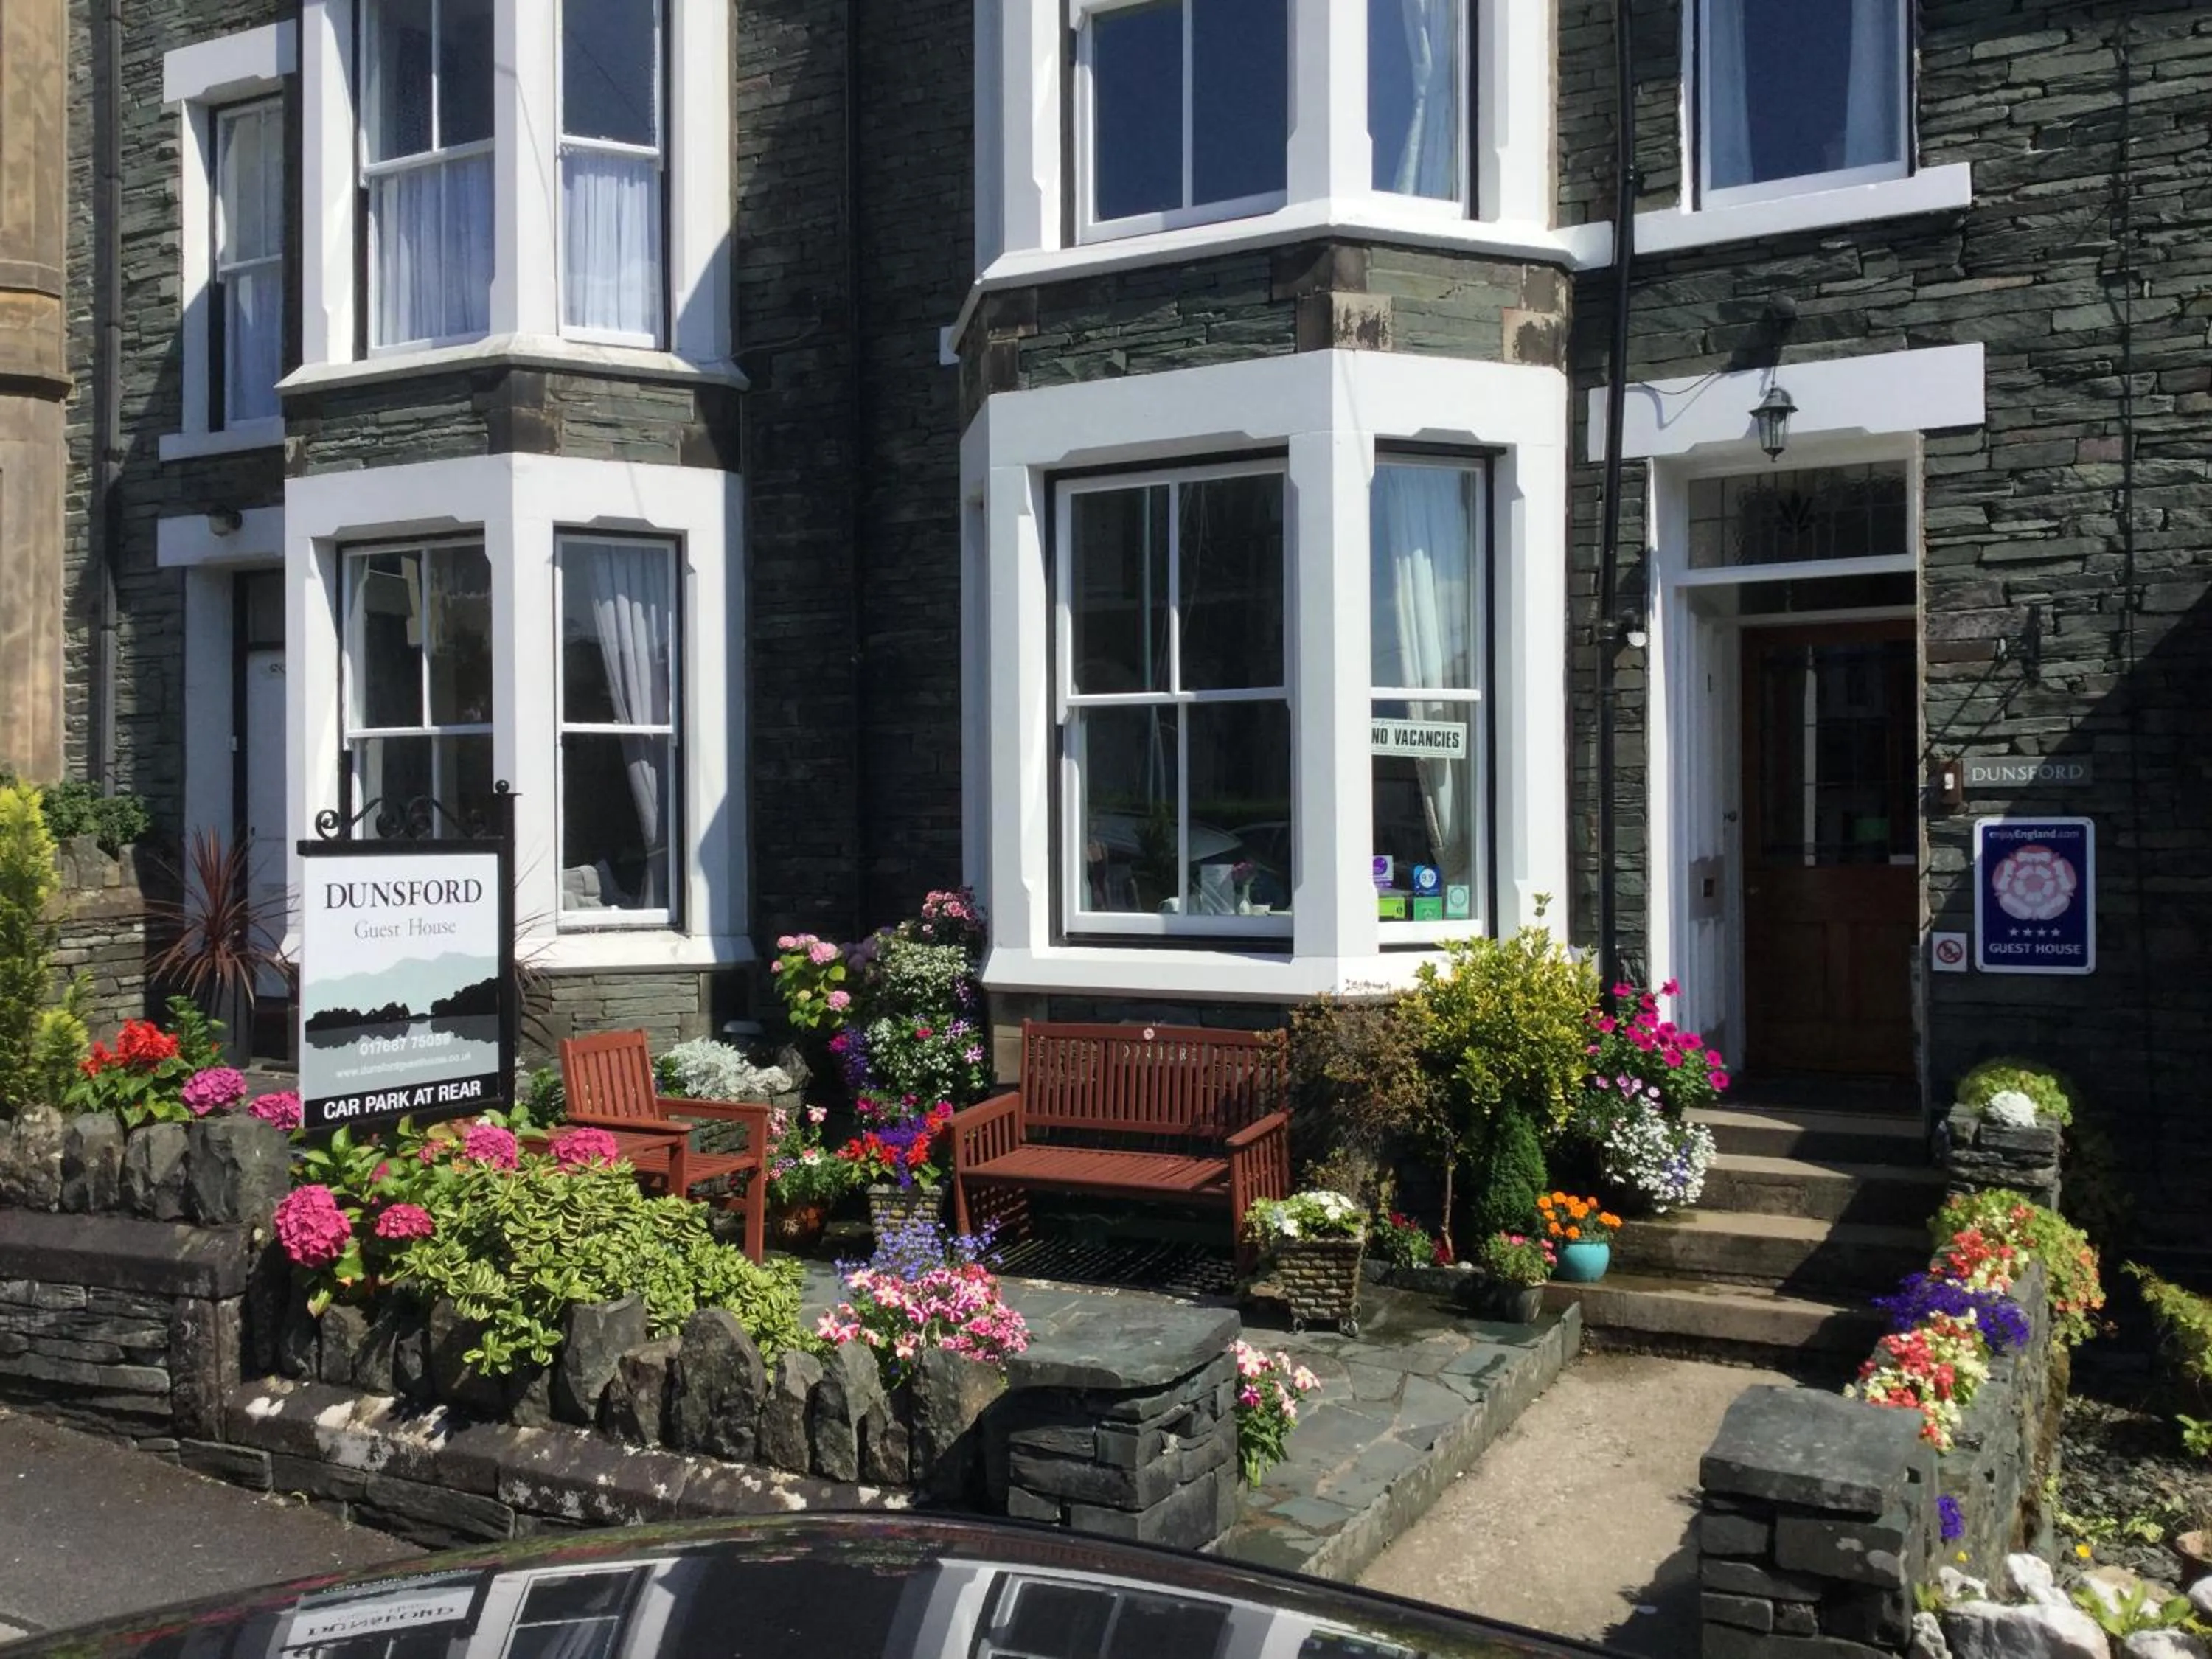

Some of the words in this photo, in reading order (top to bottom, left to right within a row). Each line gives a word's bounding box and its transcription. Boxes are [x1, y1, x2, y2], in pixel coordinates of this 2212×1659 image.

[1371, 728, 1388, 744] NO
[1394, 729, 1460, 748] VACANCIES
[1971, 764, 2084, 782] DUNSFORD
[324, 877, 484, 910] DUNSFORD
[354, 919, 400, 939] Guest
[408, 917, 456, 936] House
[1989, 942, 2032, 954] GUEST
[2035, 943, 2083, 955] HOUSE
[323, 1097, 361, 1120] CAR
[365, 1091, 411, 1113] PARK
[413, 1087, 435, 1106] AT
[438, 1079, 481, 1102] REAR
